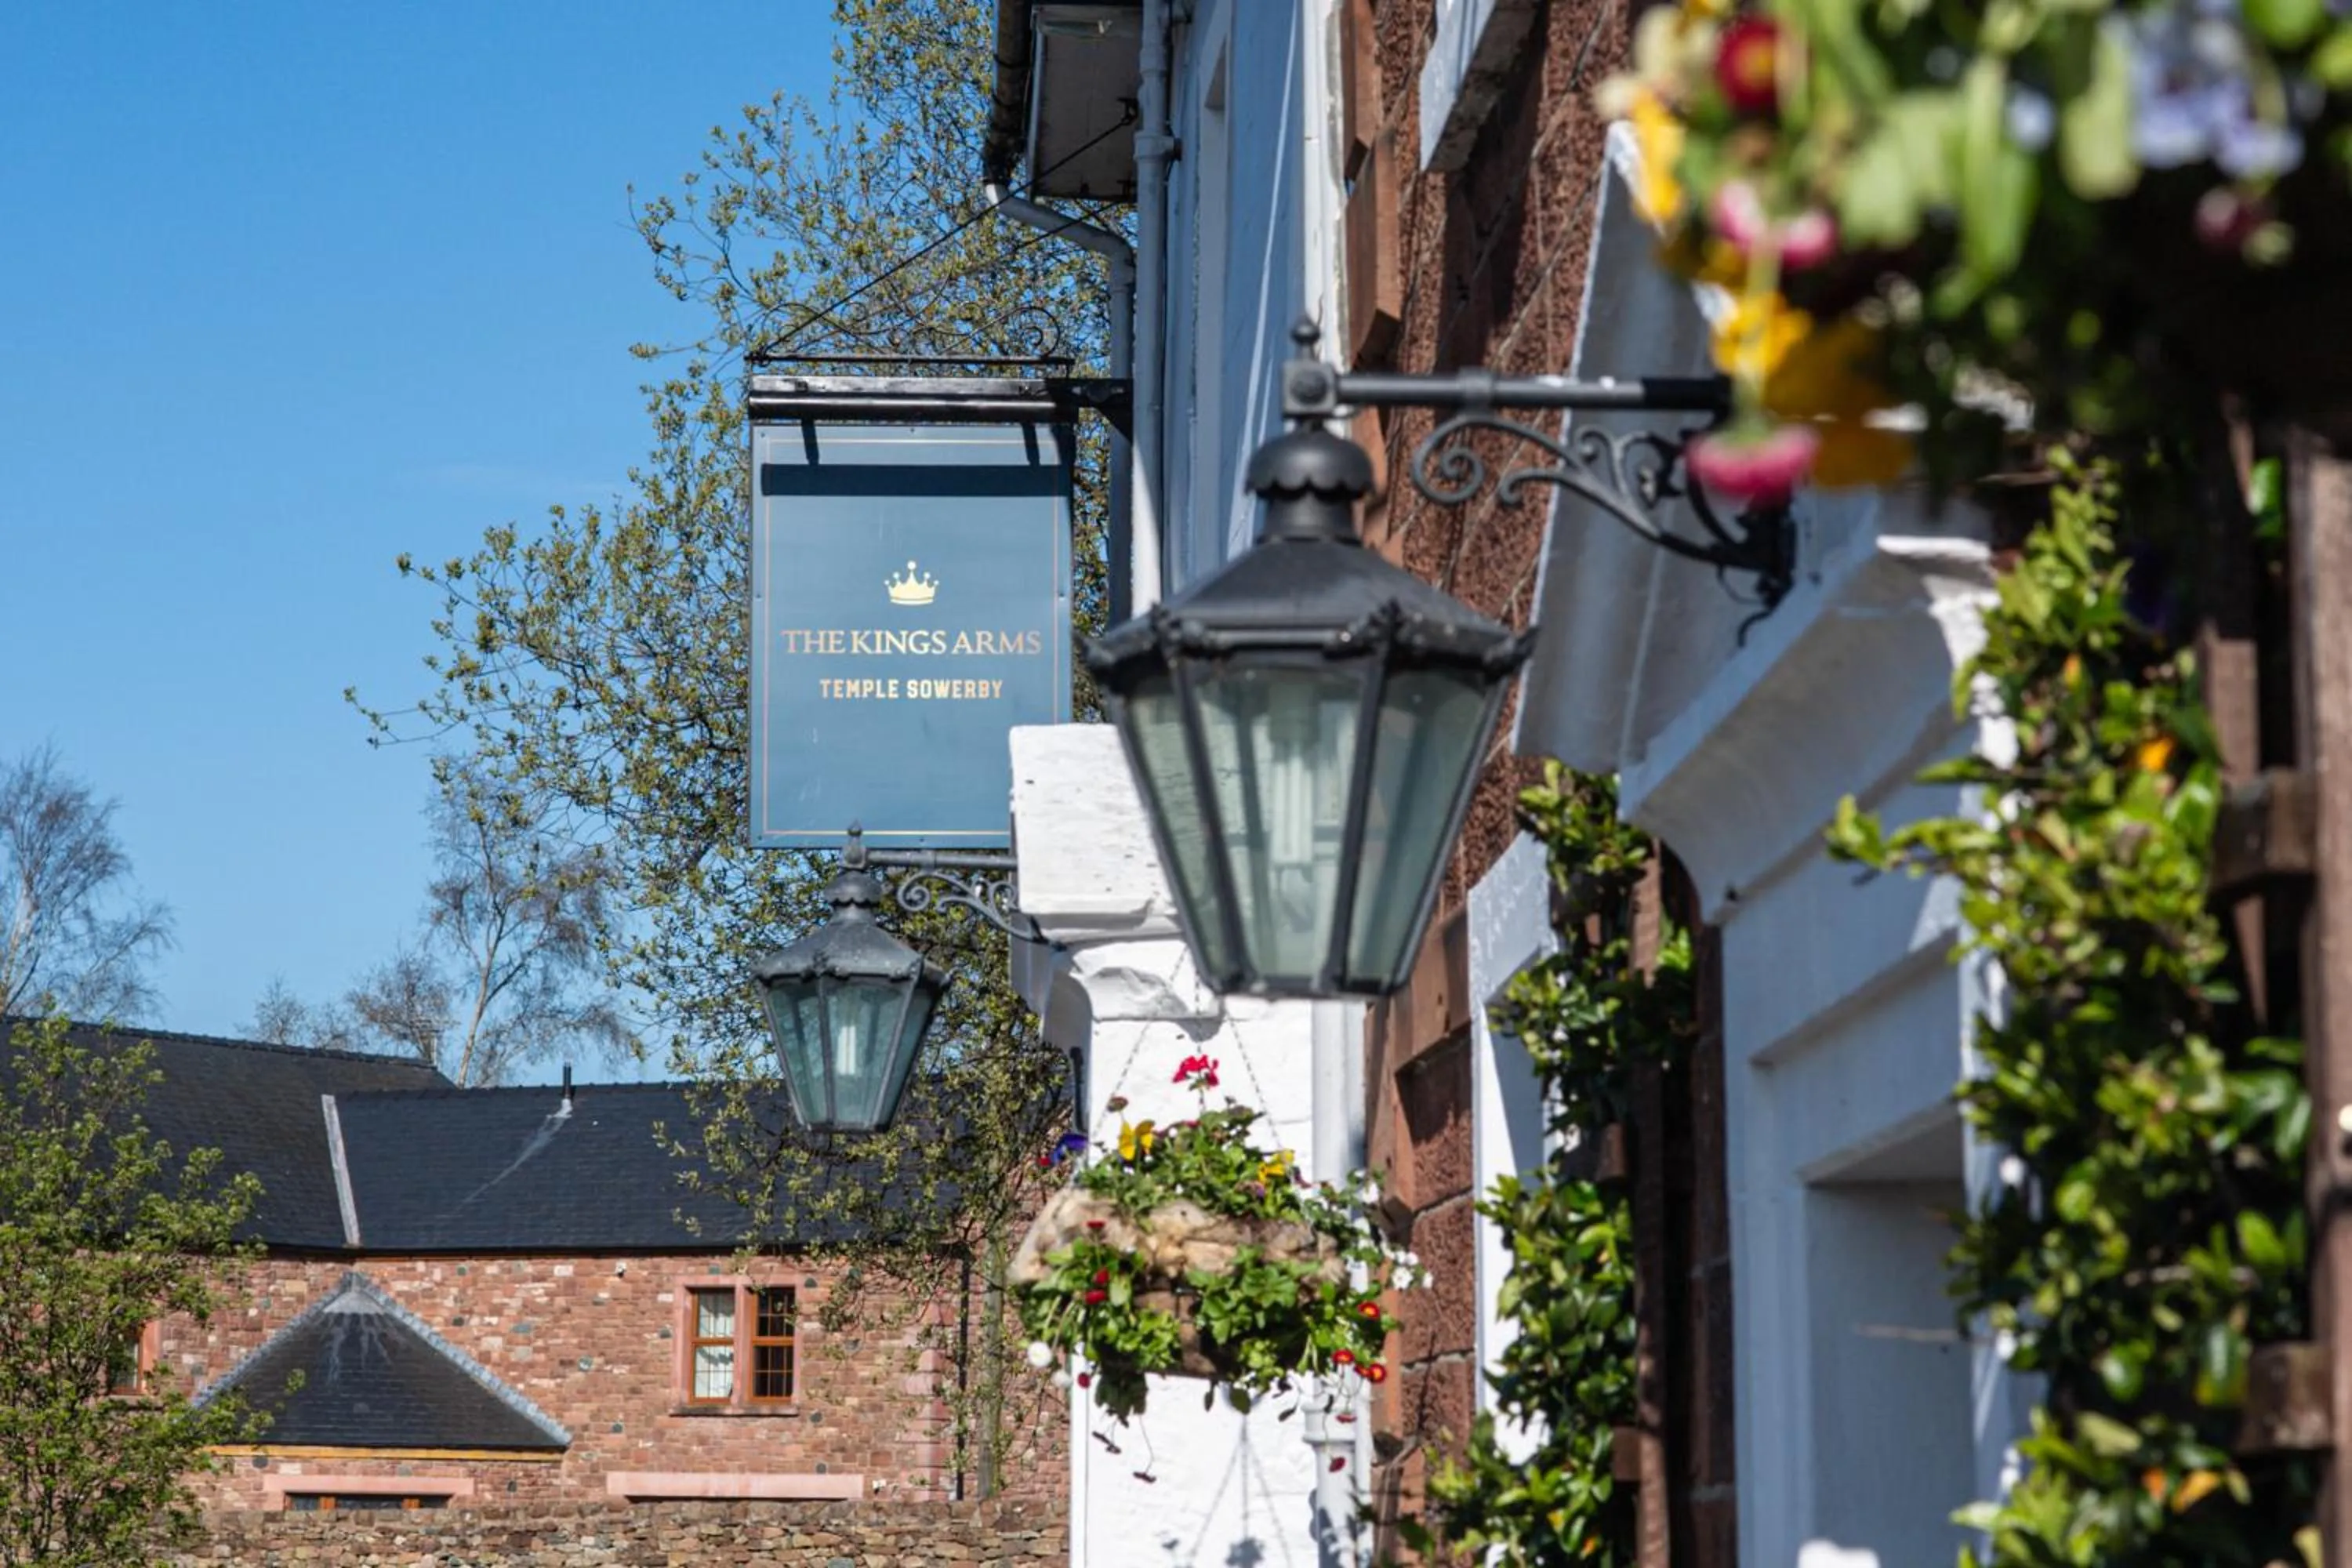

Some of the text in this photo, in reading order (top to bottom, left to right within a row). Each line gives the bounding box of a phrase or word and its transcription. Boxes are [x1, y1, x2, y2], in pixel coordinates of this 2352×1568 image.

[780, 630, 1042, 655] THE KINGS ARMS
[819, 679, 1004, 699] TEMPLE SOWERBY
